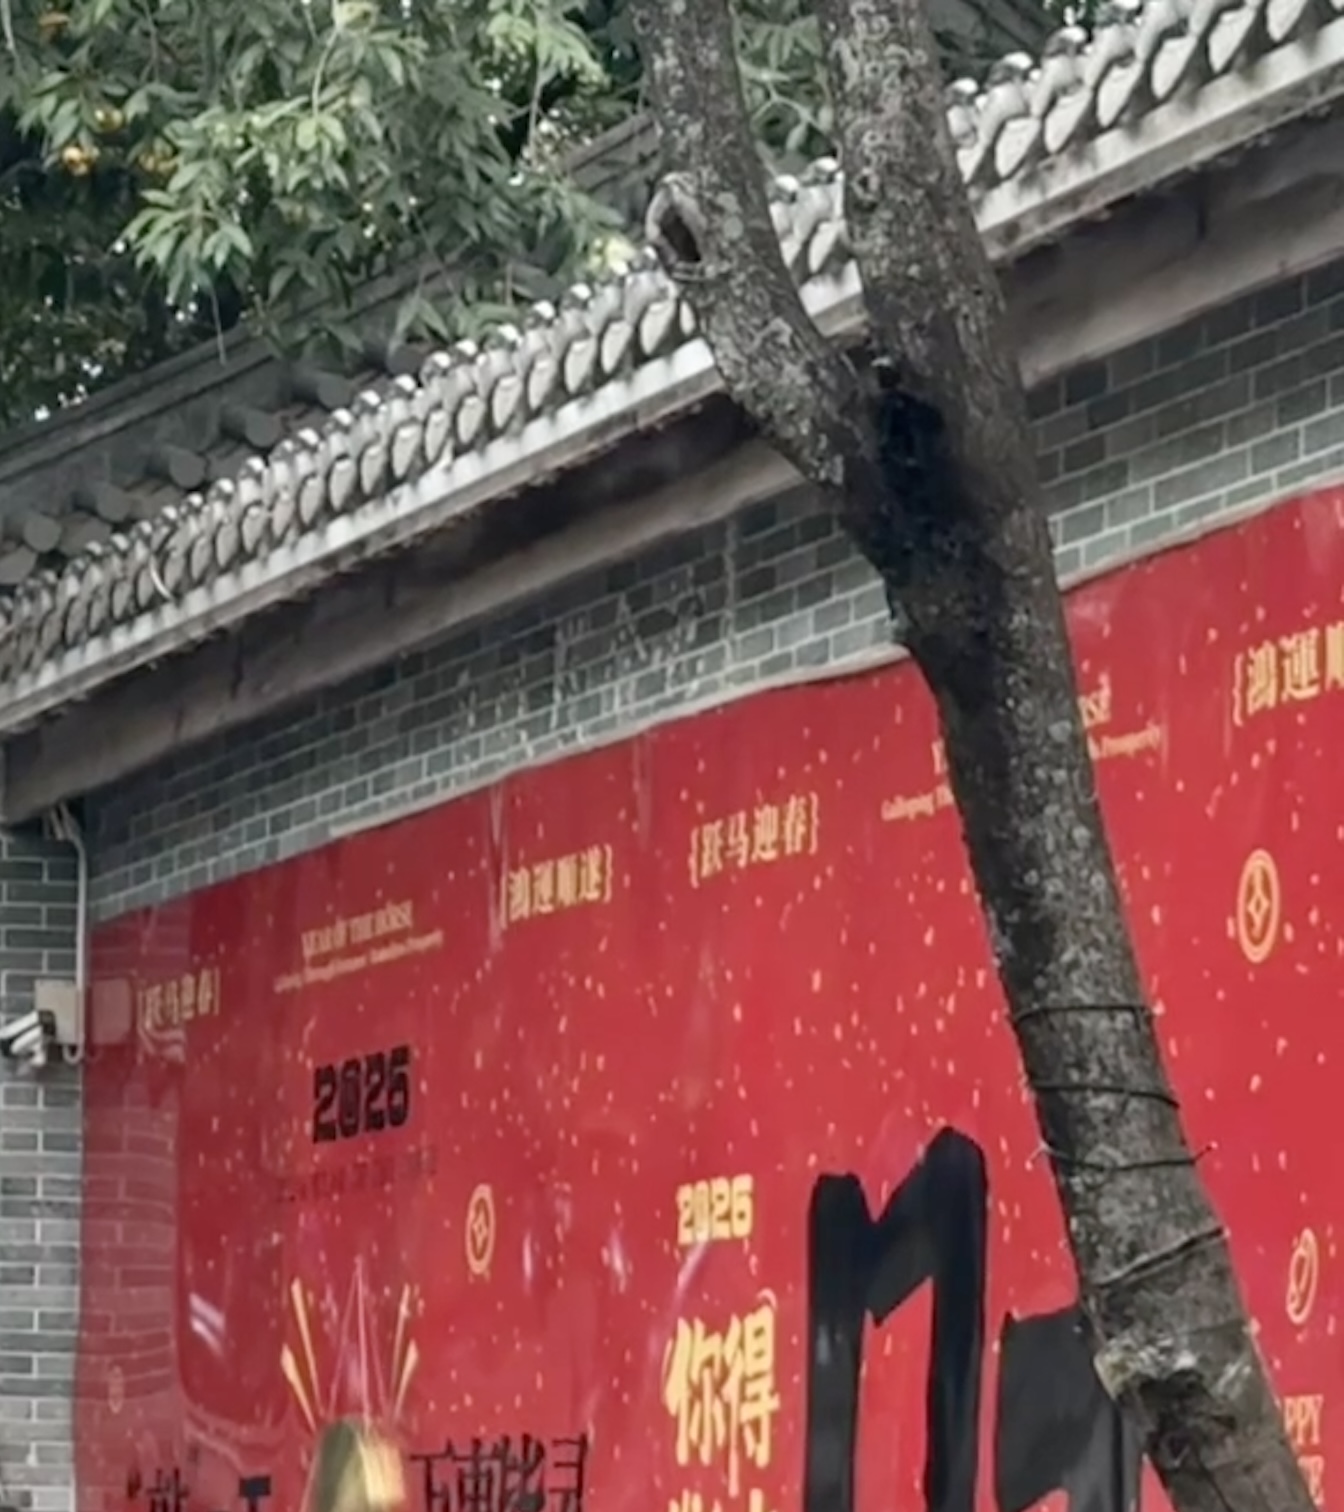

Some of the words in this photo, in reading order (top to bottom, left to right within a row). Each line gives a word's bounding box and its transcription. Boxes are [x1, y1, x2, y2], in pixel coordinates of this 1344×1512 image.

[314, 1045, 411, 1143] 2026
[675, 1174, 753, 1246] 2026
[663, 1303, 781, 1499] 你得
